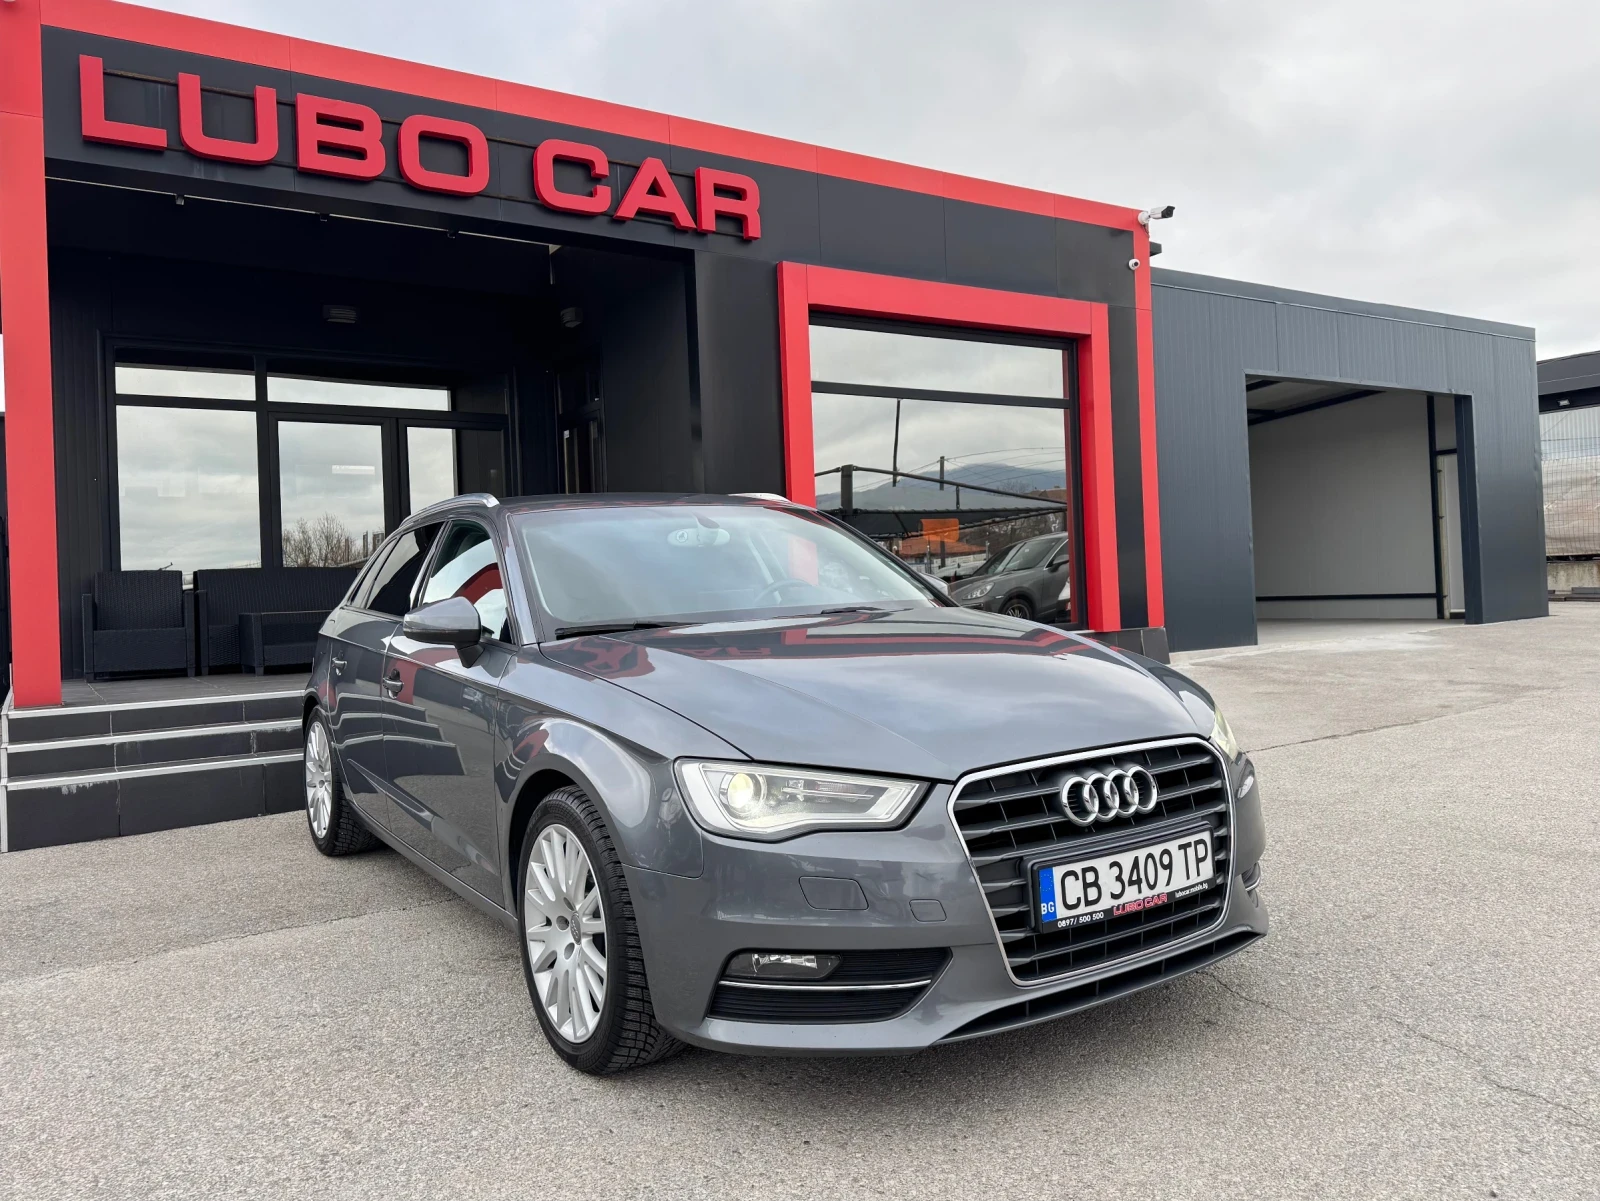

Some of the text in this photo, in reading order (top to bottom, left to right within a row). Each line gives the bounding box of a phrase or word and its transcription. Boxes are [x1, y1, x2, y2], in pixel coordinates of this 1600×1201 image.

[79, 54, 762, 241] LUBO CAR
[1061, 838, 1208, 911] CB 3409 TP
[1041, 902, 1055, 915] BG
[1113, 893, 1168, 916] LUBO CAR
[1079, 914, 1091, 924] 500
[1092, 911, 1104, 921] 500
